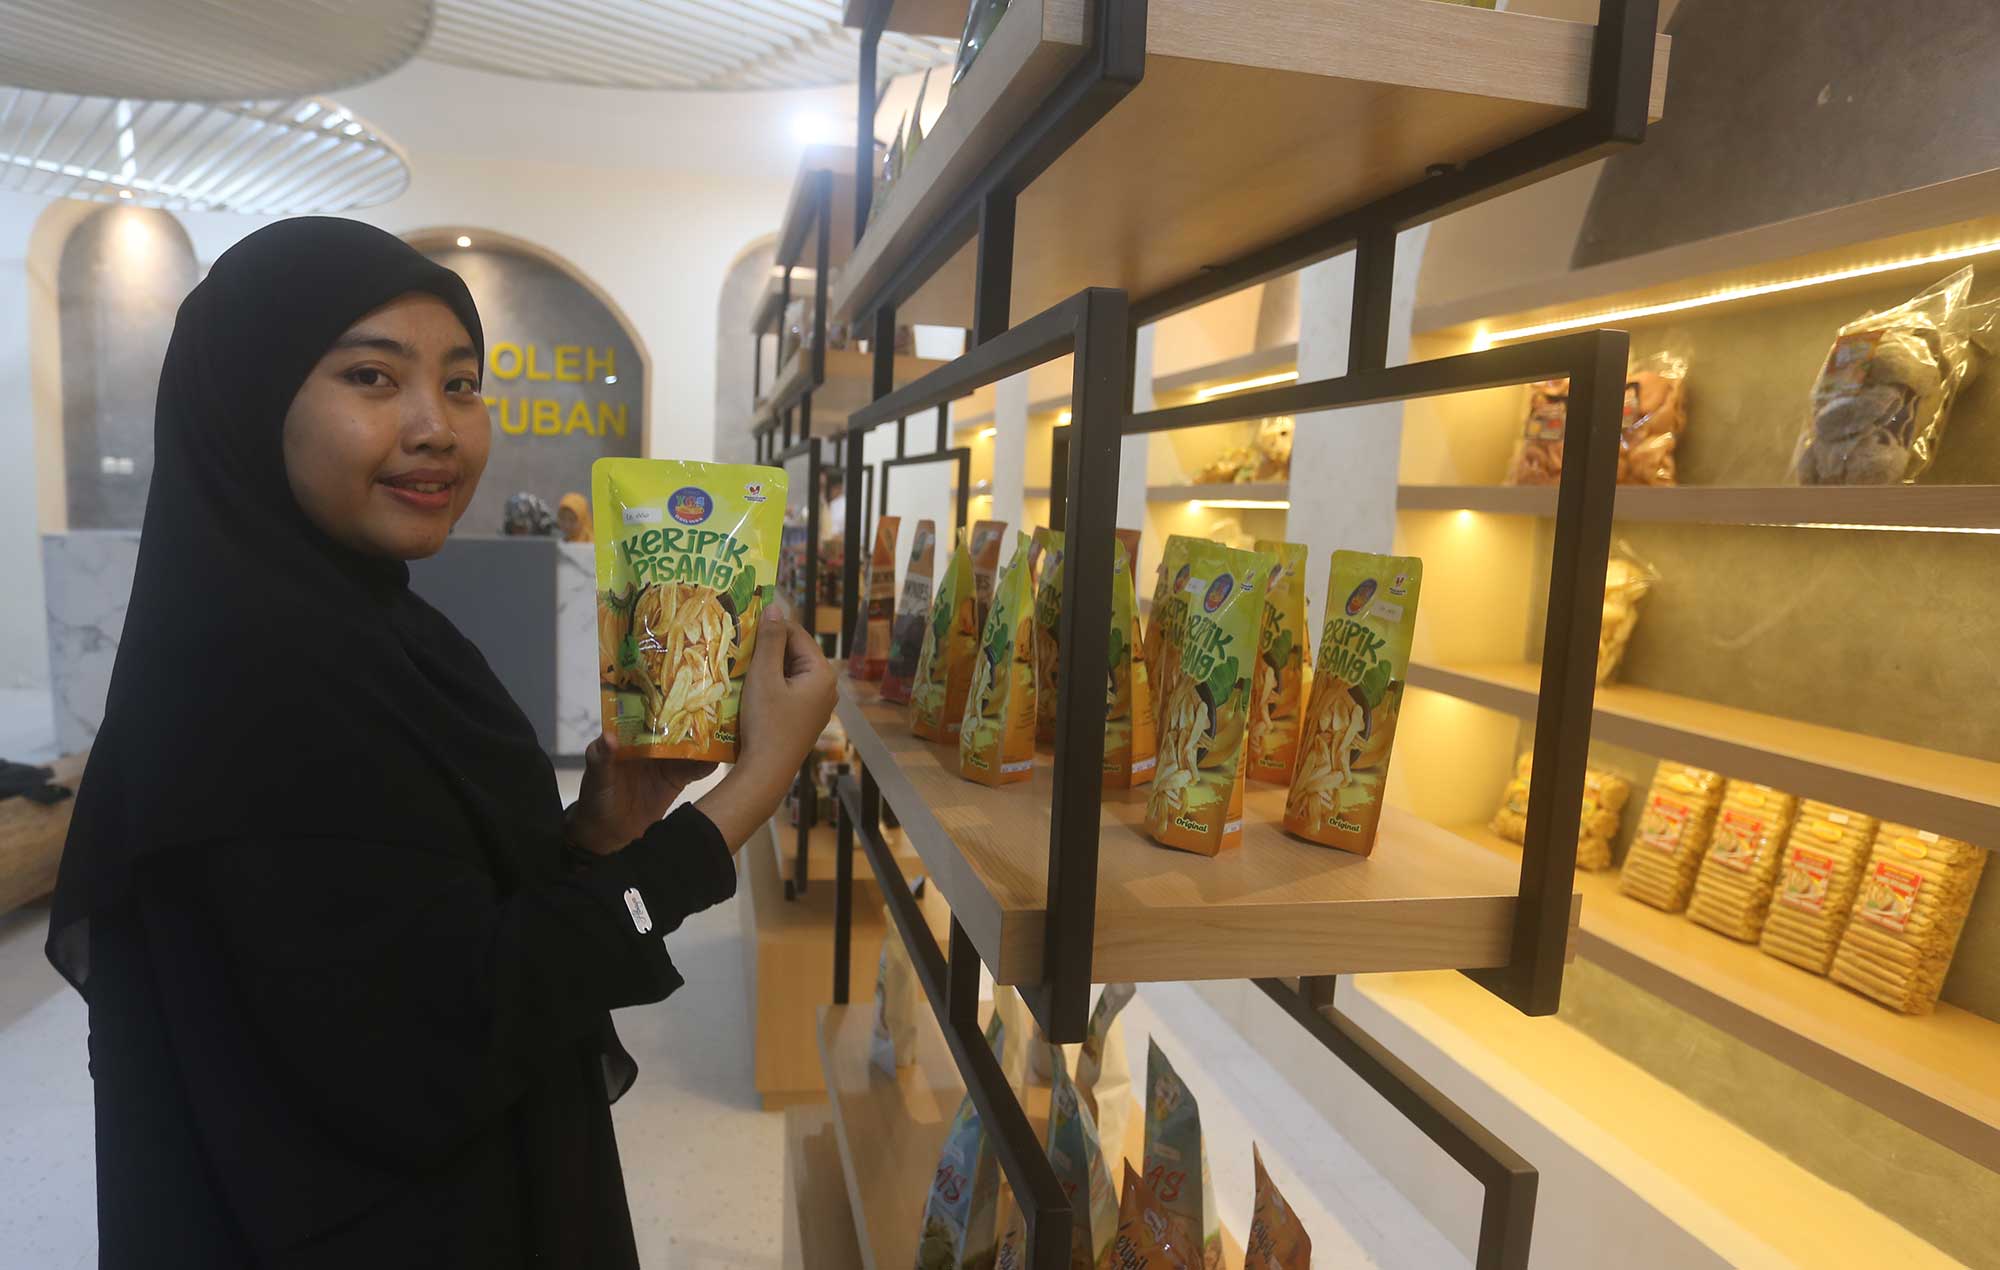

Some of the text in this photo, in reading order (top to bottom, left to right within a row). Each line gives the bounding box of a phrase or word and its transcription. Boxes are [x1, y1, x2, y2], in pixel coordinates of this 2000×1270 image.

[489, 341, 616, 383] OLEH
[1176, 817, 1208, 833] Original
[1329, 817, 1361, 833] Original
